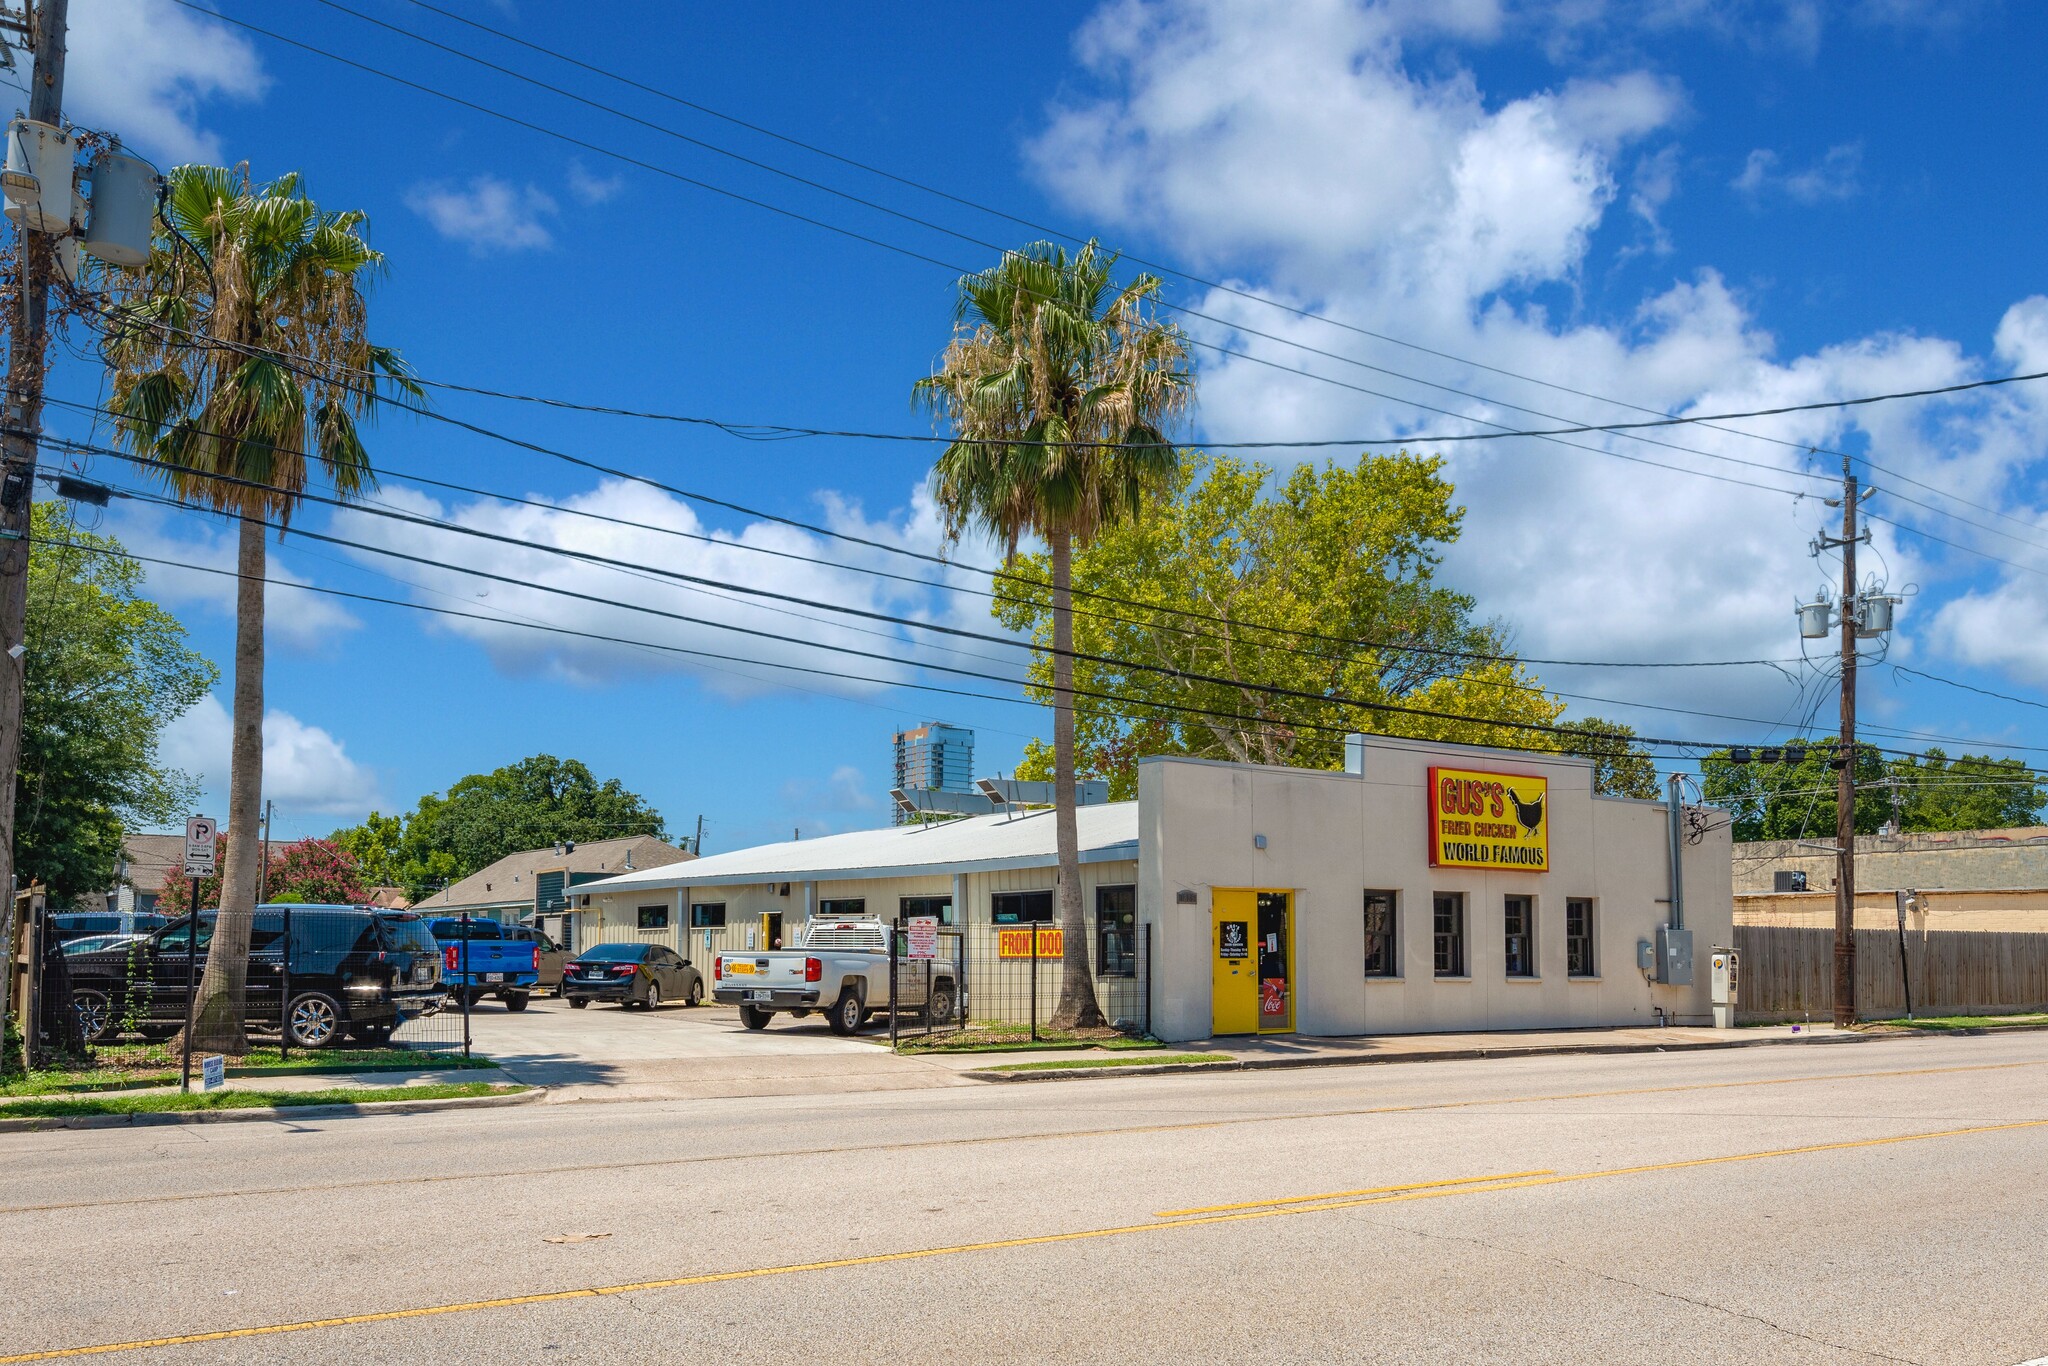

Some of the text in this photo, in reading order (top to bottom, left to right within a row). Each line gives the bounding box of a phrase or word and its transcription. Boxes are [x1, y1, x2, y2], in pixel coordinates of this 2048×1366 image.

[1441, 777, 1504, 818] GUS'S
[1441, 820, 1517, 839] FRIED CHICKEN
[1443, 842, 1544, 865] WORLD FAMOUS
[1040, 932, 1063, 955] DOO
